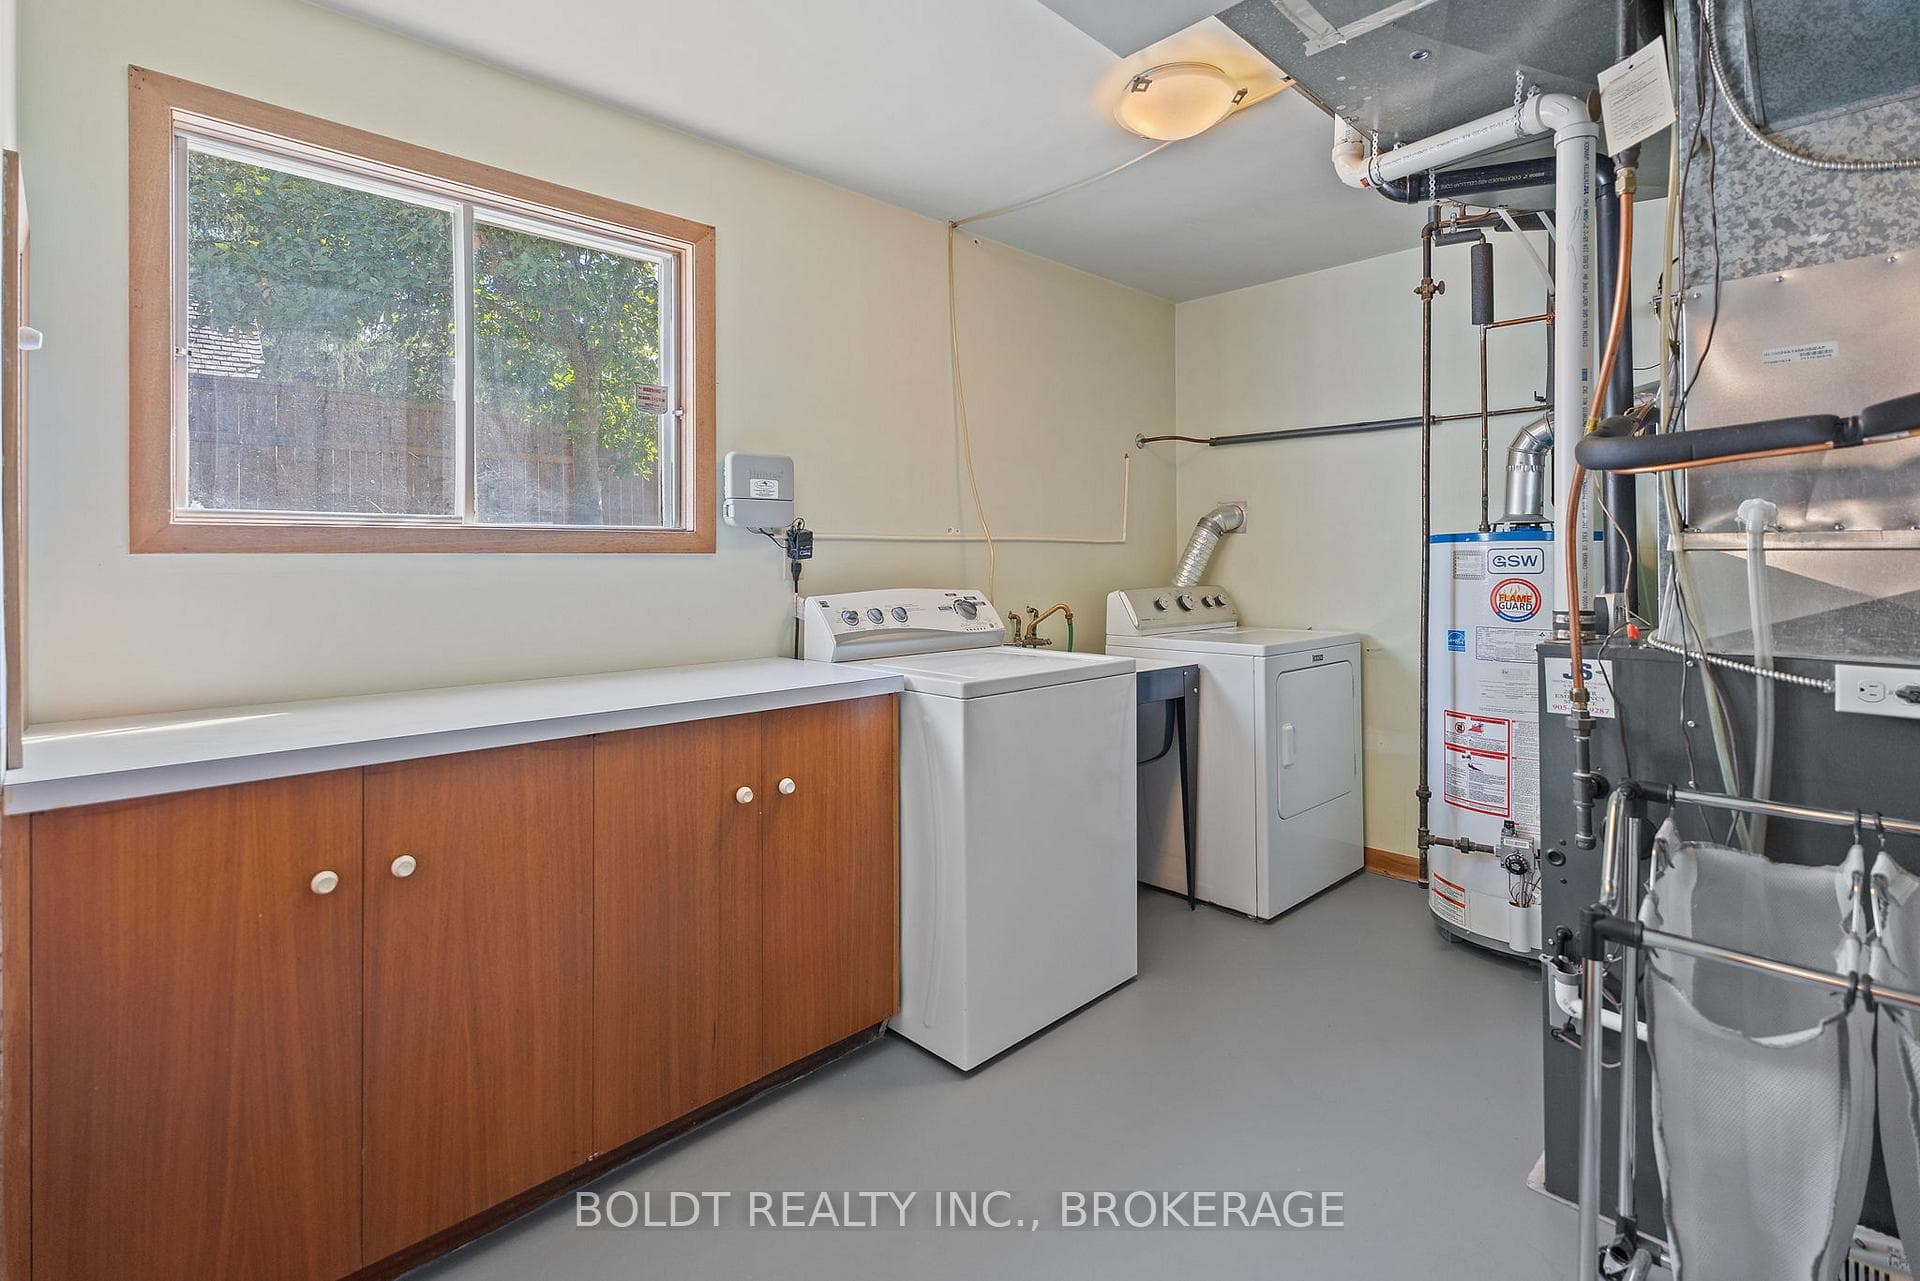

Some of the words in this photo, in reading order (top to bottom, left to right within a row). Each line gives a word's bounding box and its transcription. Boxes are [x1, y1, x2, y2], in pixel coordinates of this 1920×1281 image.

[1492, 555, 1538, 567] GSW
[1499, 593, 1532, 603] FLAME
[1498, 602, 1533, 611] GUARD
